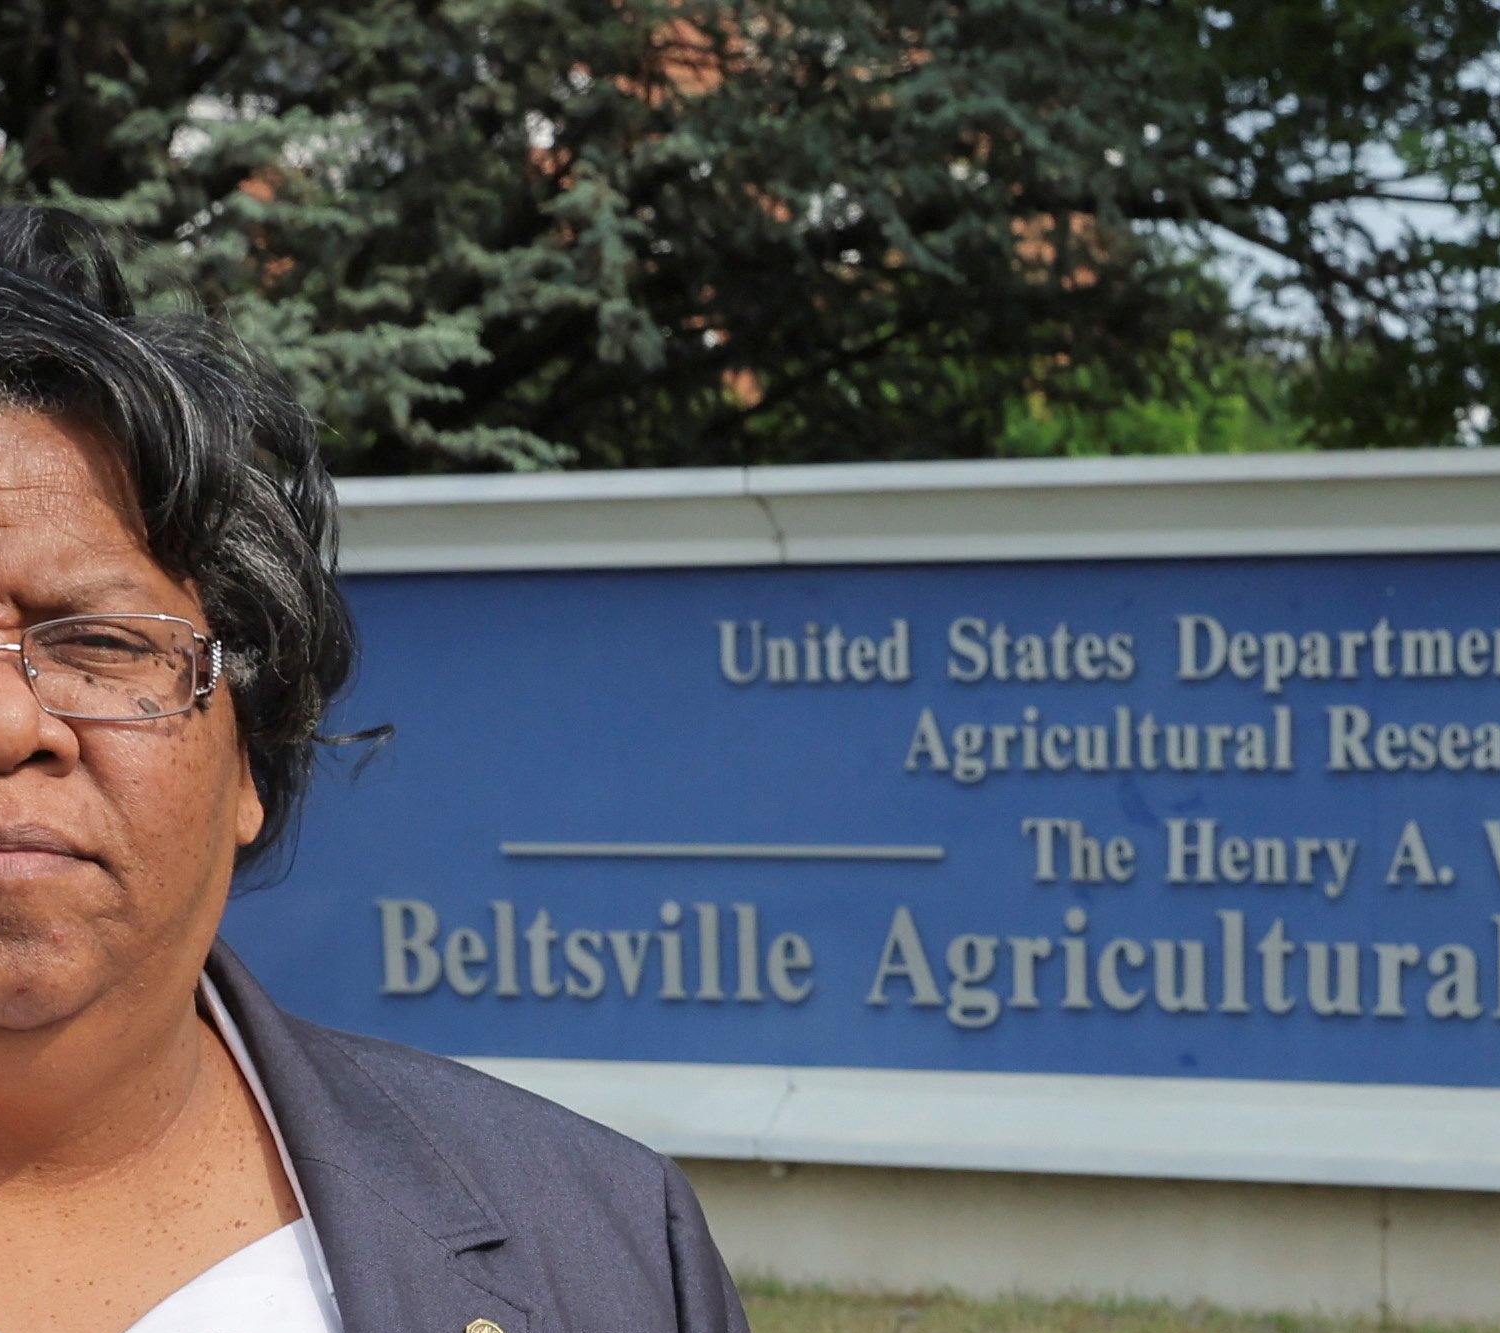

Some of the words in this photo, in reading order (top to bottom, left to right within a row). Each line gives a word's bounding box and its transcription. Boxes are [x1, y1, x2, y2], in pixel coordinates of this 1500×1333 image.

[718, 619, 912, 684] United
[946, 617, 1135, 681] States
[904, 706, 1293, 783] Agricultural
[1022, 817, 1136, 883] The
[1165, 818, 1357, 898] Henry
[1386, 820, 1454, 884] A.
[376, 898, 816, 1002] Beltsville
